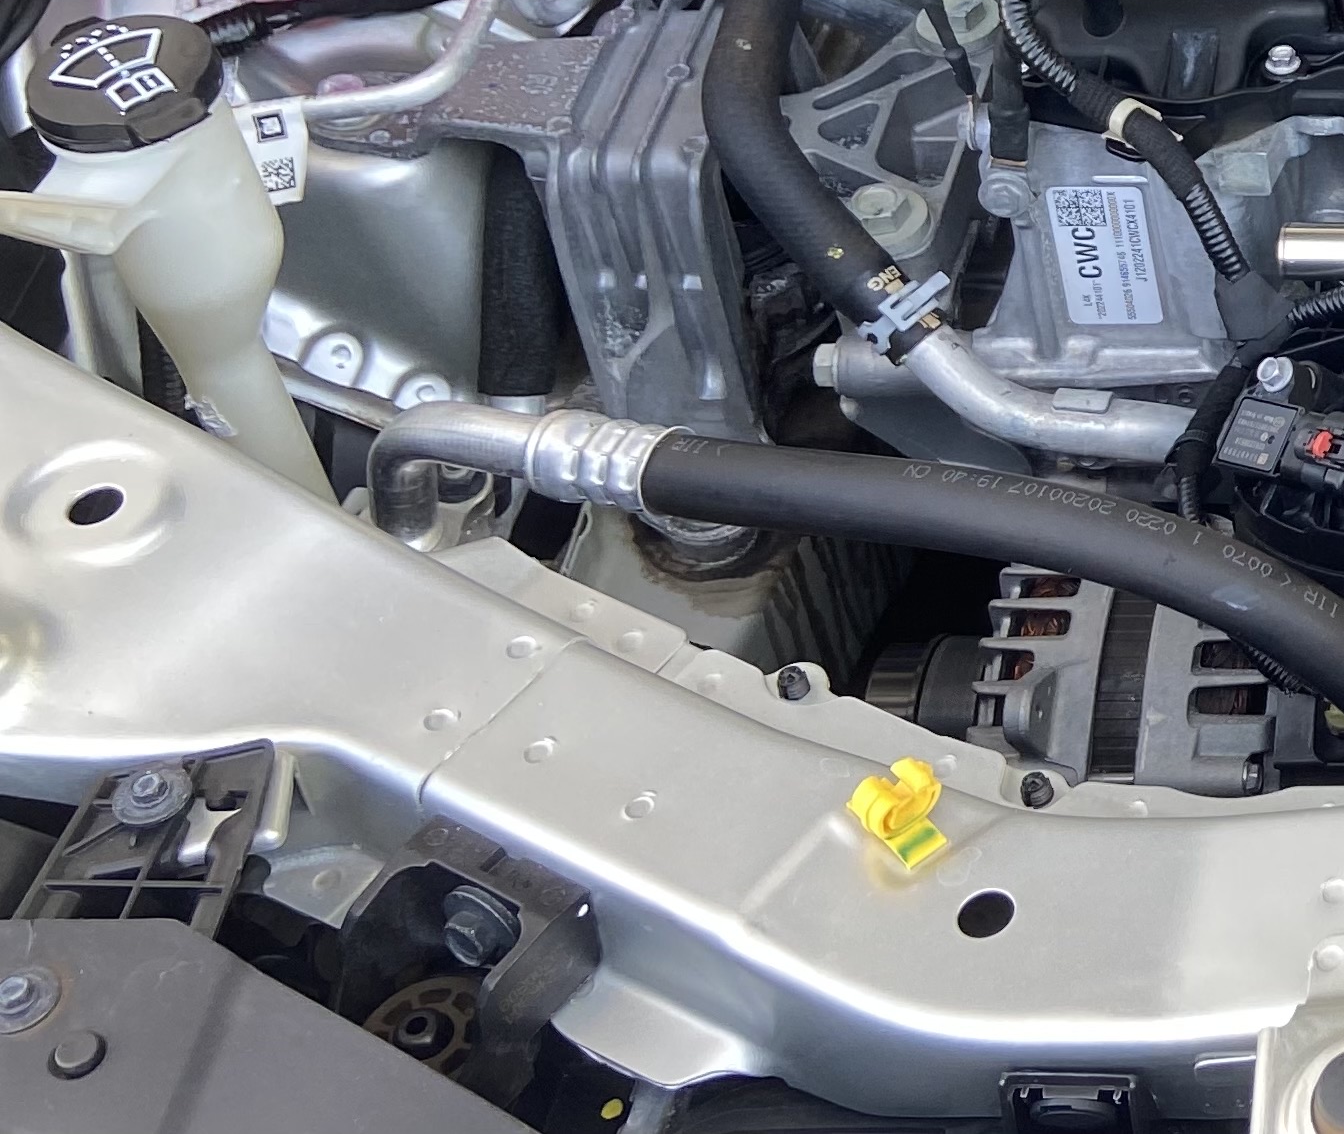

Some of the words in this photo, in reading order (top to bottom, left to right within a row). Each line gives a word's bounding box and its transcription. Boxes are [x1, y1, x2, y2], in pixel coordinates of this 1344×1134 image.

[1071, 227, 1103, 279] CWC
[866, 265, 902, 292] ENG
[941, 468, 1004, 490] 19:40
[1007, 479, 1117, 516] 20200107
[1126, 508, 1178, 535] 0220
[1222, 544, 1274, 578] 0070
